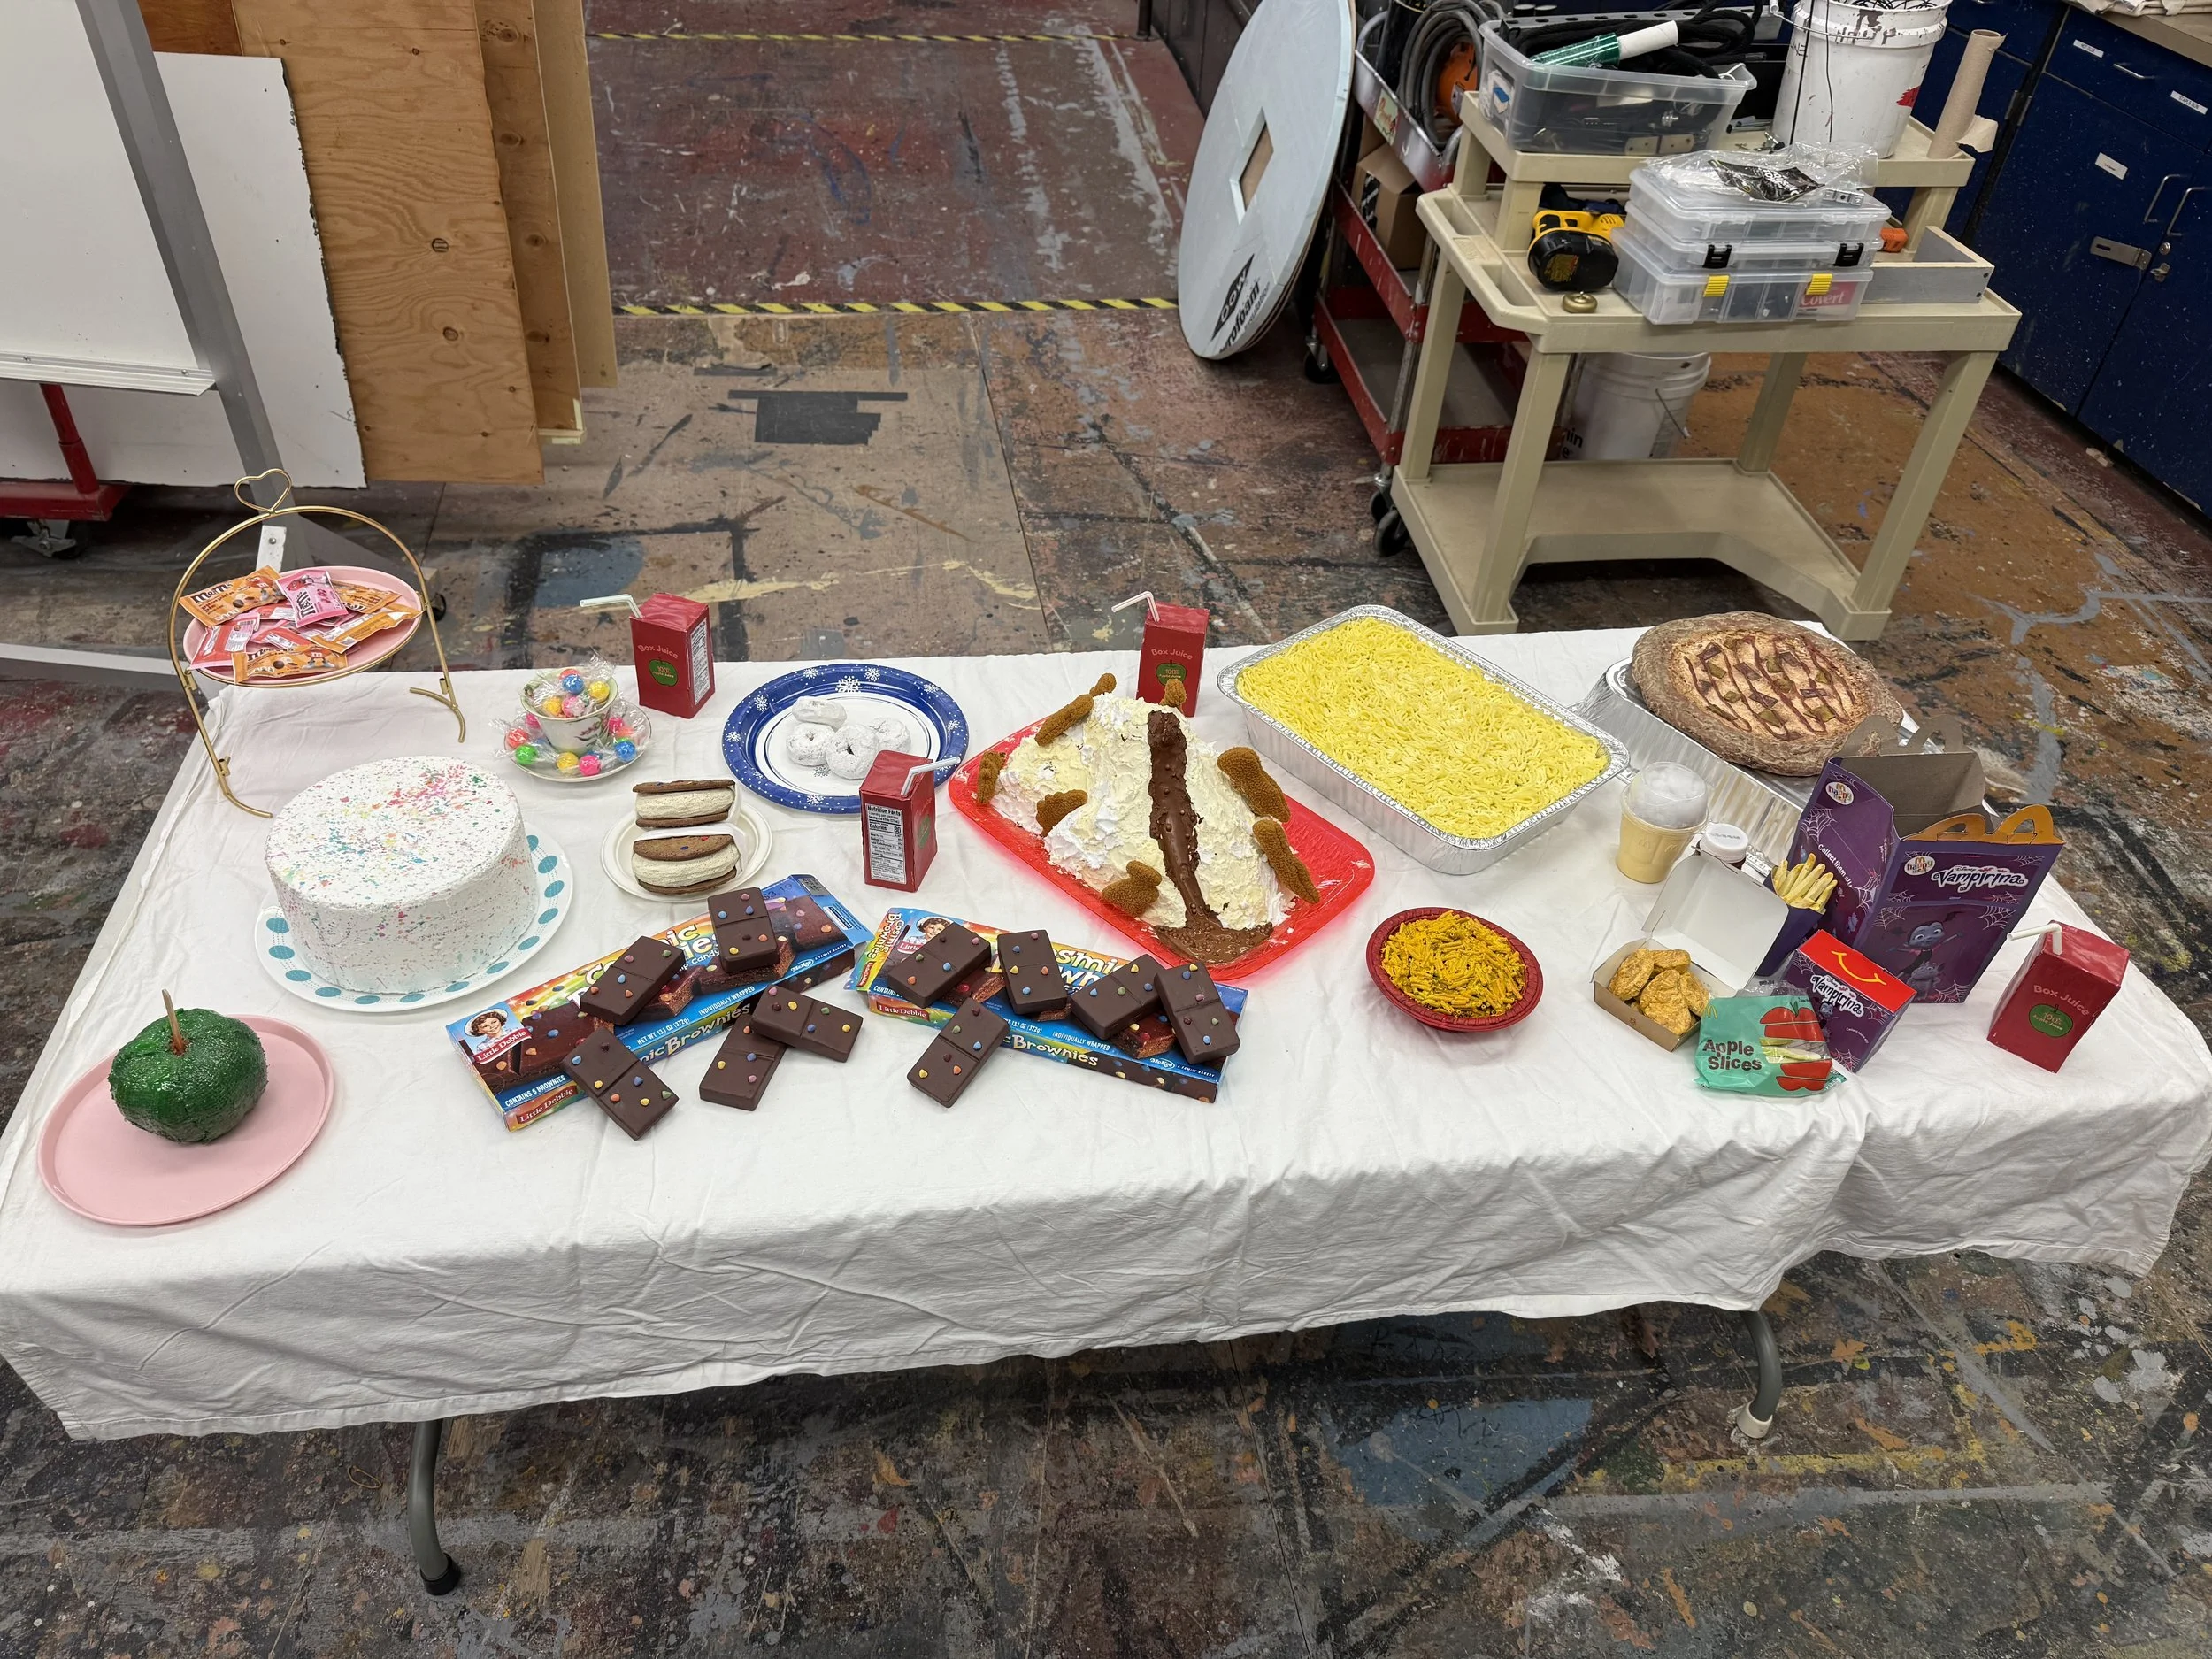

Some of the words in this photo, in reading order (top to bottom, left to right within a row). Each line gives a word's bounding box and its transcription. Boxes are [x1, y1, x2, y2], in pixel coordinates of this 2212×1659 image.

[1221, 267, 1247, 322] DOW
[657, 645, 679, 659] Juice
[1170, 648, 1193, 660] Juice
[867, 805, 888, 814] Nutrition
[1817, 843, 1837, 864] Collect
[1834, 859, 1847, 877] them
[1932, 870, 2025, 892] Vampirina
[867, 912, 902, 959] Brownies
[881, 919, 905, 953] Cosmic
[900, 942, 919, 951] Little
[691, 949, 720, 964] candy
[698, 997, 732, 1016] INDIVIDUALLY
[732, 986, 755, 1001] WRAPPED
[873, 985, 896, 996] CONTAINS
[1811, 976, 1862, 1015] Vampirina
[2033, 984, 2059, 997] Box
[2060, 994, 2090, 1016] Juice
[879, 1004, 899, 1015] Little
[900, 1008, 927, 1018] Debbie
[636, 1035, 648, 1046] NET
[657, 1026, 666, 1036] 13.1
[673, 1017, 690, 1030] (372g)
[665, 1003, 750, 1056] Brownies
[1026, 1025, 1042, 1034] (372g)
[1052, 1031, 1087, 1044] INDIVIDUALLY
[1086, 1040, 1110, 1051] WRAPPED
[477, 1047, 499, 1061] Little
[500, 1030, 526, 1049] Debbie
[1011, 1034, 1098, 1066] Brownies
[1702, 1039, 1755, 1057] Apple
[1708, 1056, 1763, 1071] Slices
[504, 1090, 533, 1107] CONTAINS
[537, 1074, 566, 1092] BROWNIES
[520, 1107, 543, 1122] Little
[544, 1088, 573, 1108] Debbie
